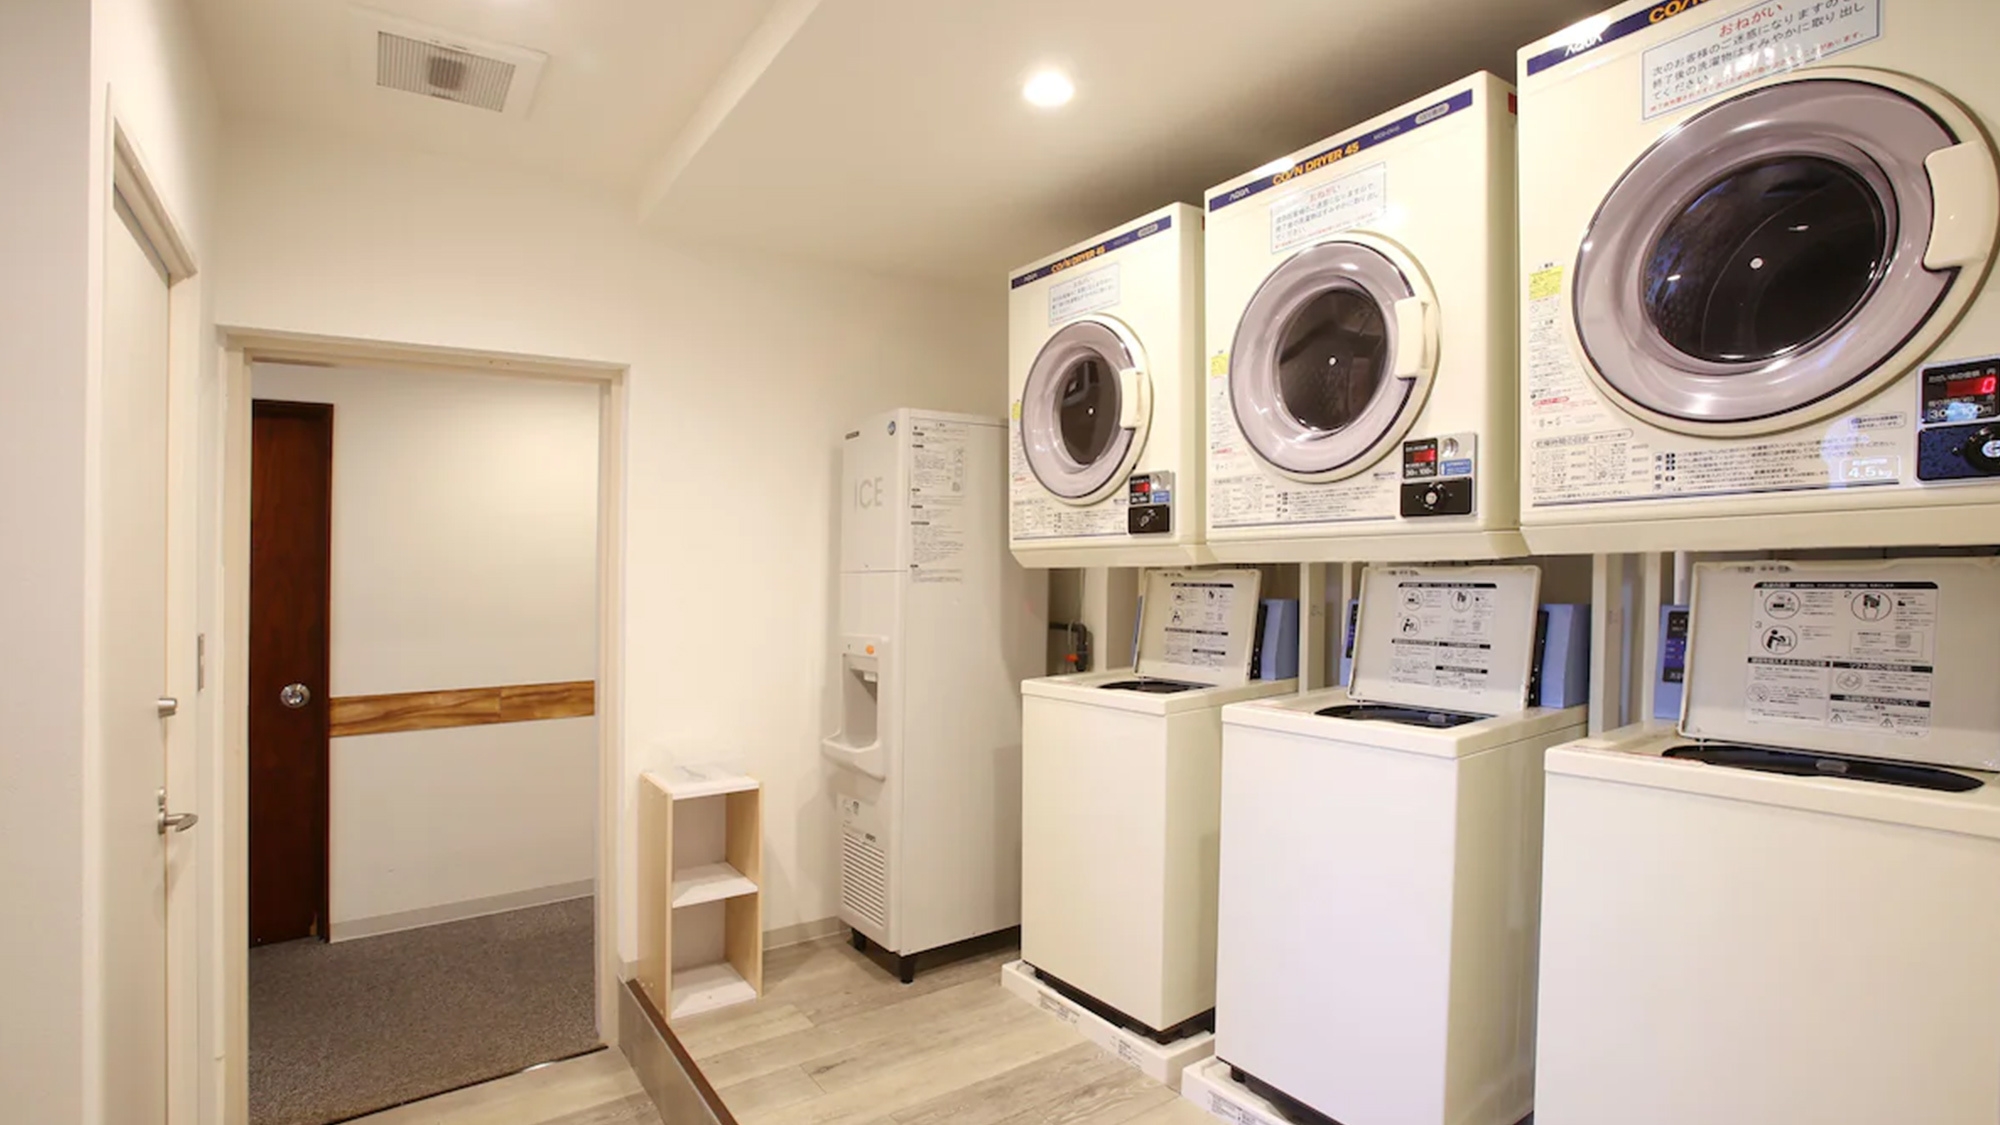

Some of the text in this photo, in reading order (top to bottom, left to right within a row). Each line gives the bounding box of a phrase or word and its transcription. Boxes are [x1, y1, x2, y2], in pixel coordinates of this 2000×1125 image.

[1719, 4, 1784, 38] おねがい
[1653, 0, 1852, 77] 次のお客様のご迷惑になりますの
[1305, 147, 1344, 173] DRYER
[1344, 141, 1360, 157] 45
[1981, 376, 1996, 394] 0
[853, 475, 884, 514] ICE
